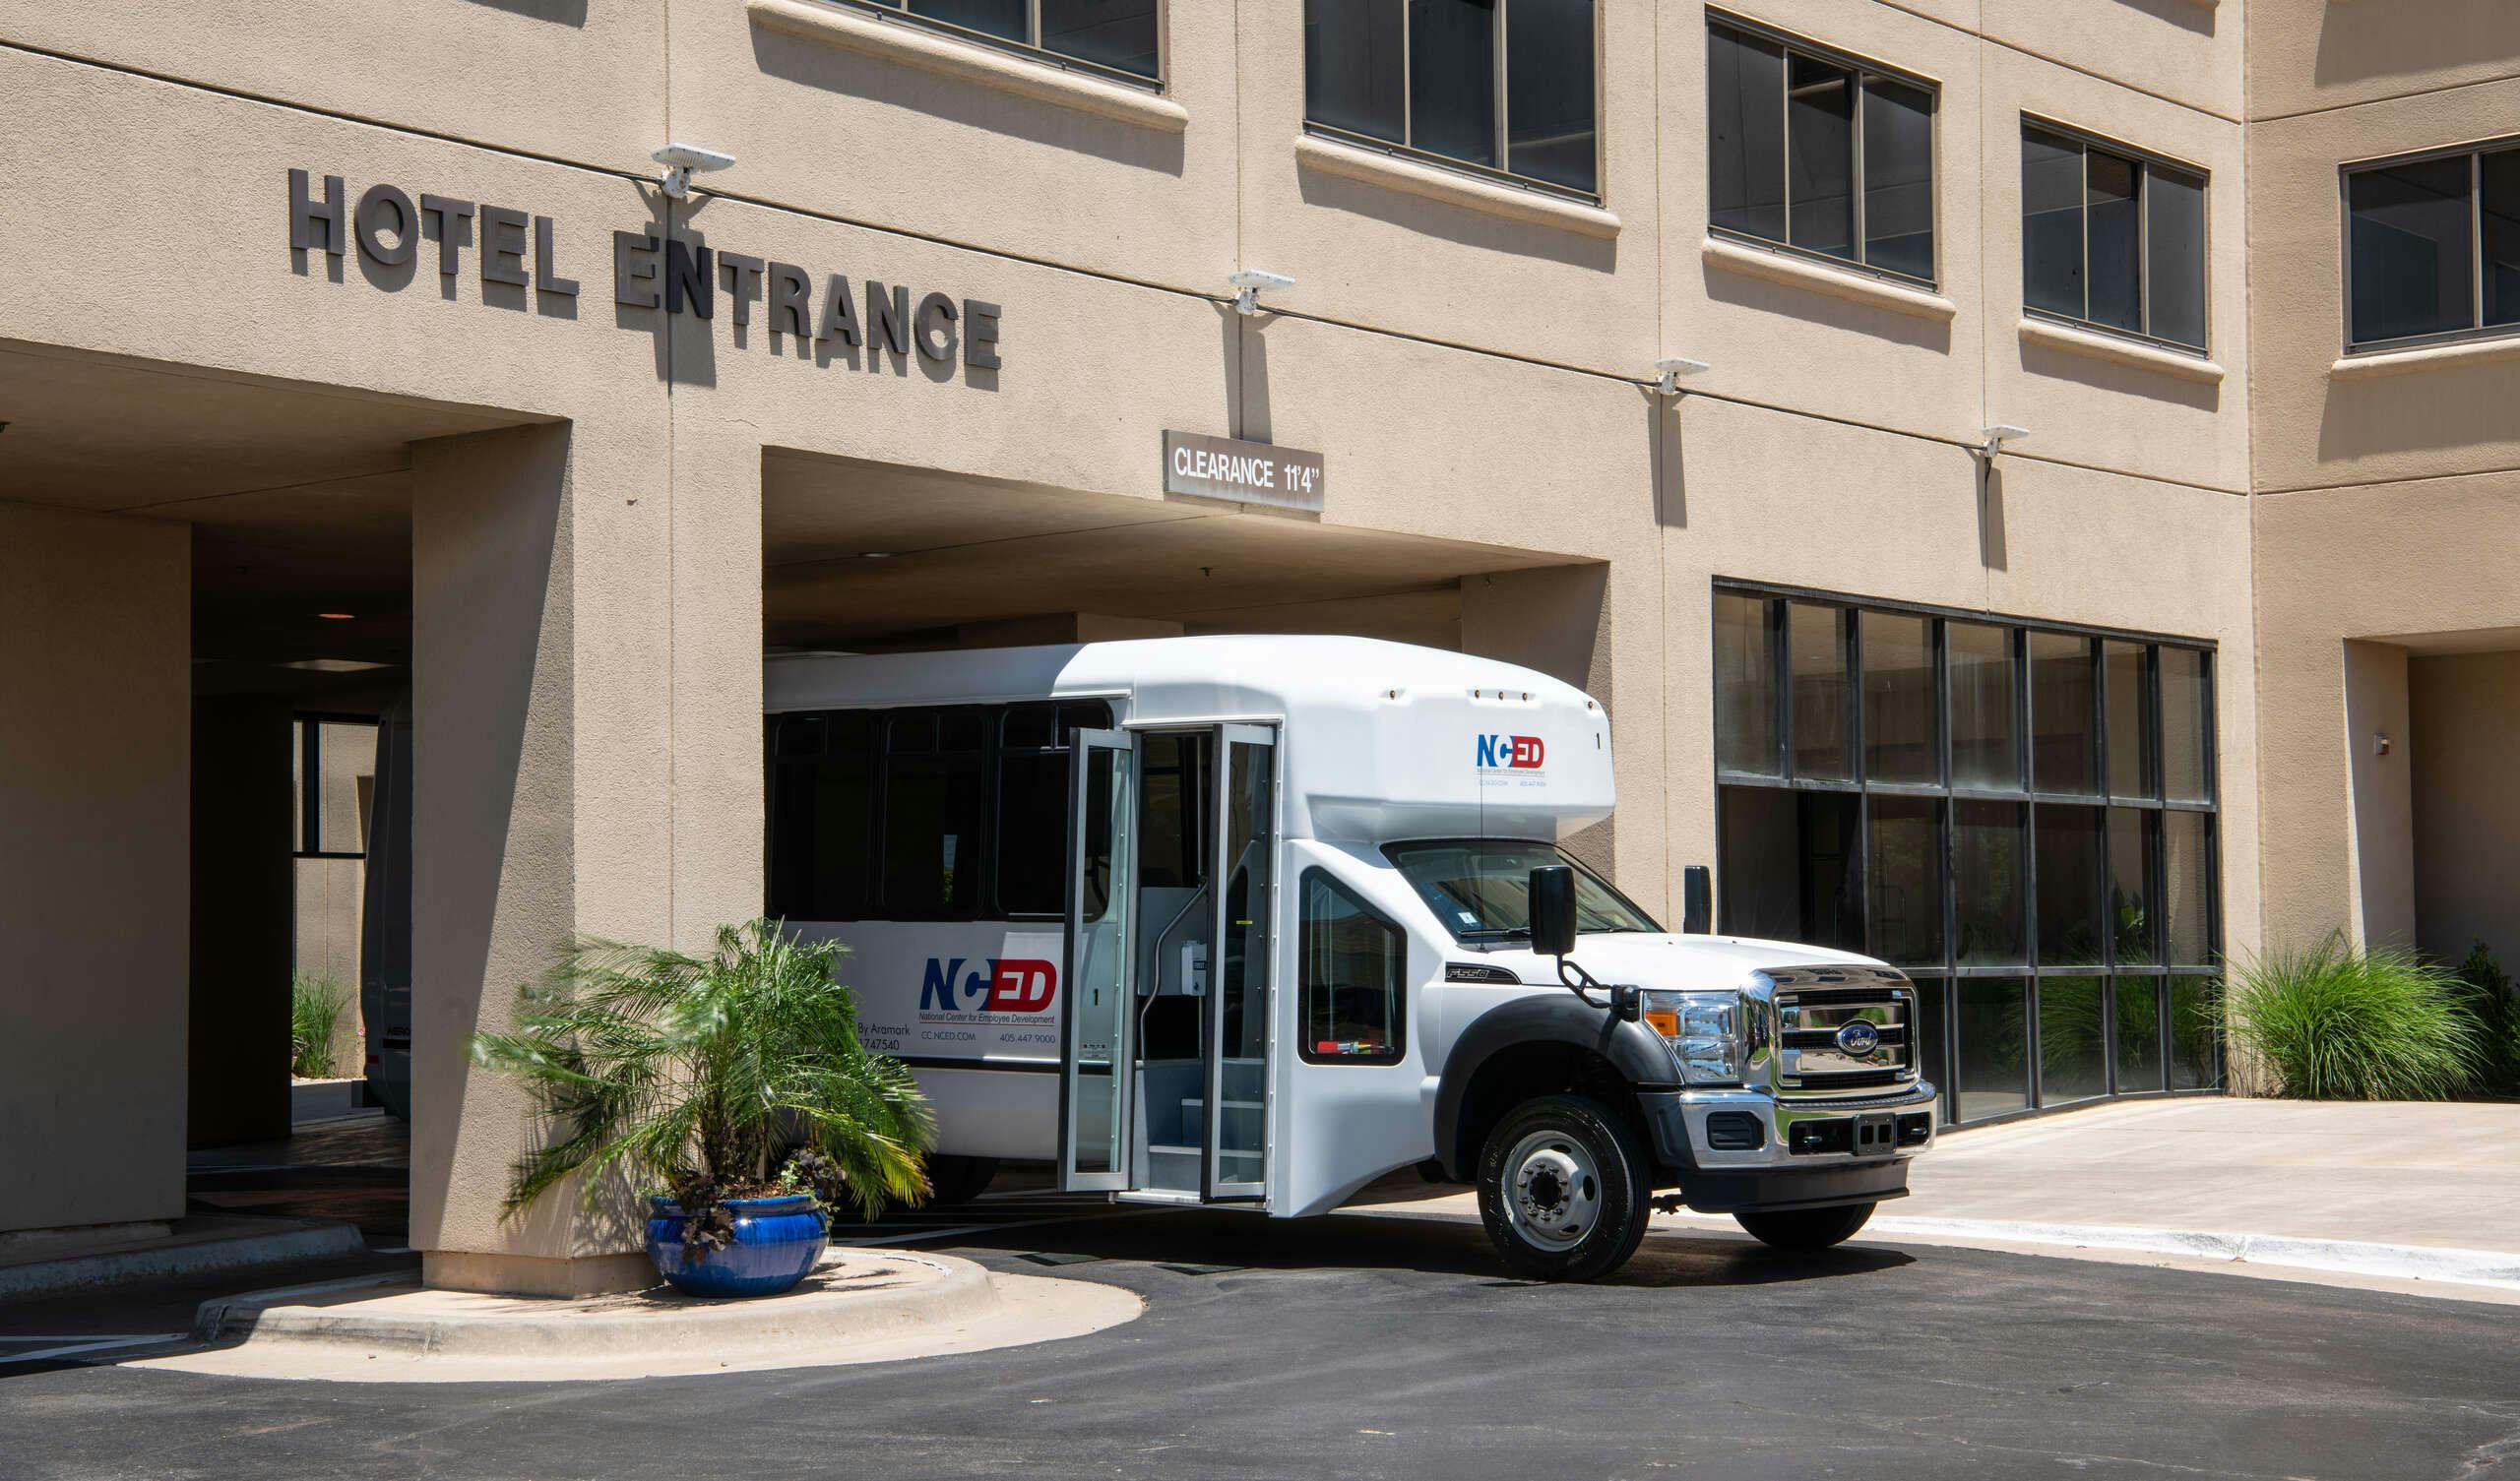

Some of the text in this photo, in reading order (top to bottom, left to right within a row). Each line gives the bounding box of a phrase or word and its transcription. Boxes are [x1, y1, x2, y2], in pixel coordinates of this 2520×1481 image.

[288, 168, 1002, 369] HOTEL ENTRANCE
[1174, 447, 1275, 488] CLEARANCE
[1477, 734, 1544, 769] NCED
[918, 957, 1057, 1013] NCED
[1094, 988, 1100, 1006] 1
[858, 1022, 911, 1036] By Aramark
[918, 1012, 1055, 1024] National Center for Employee Development
[1851, 1029, 1872, 1047] Ford
